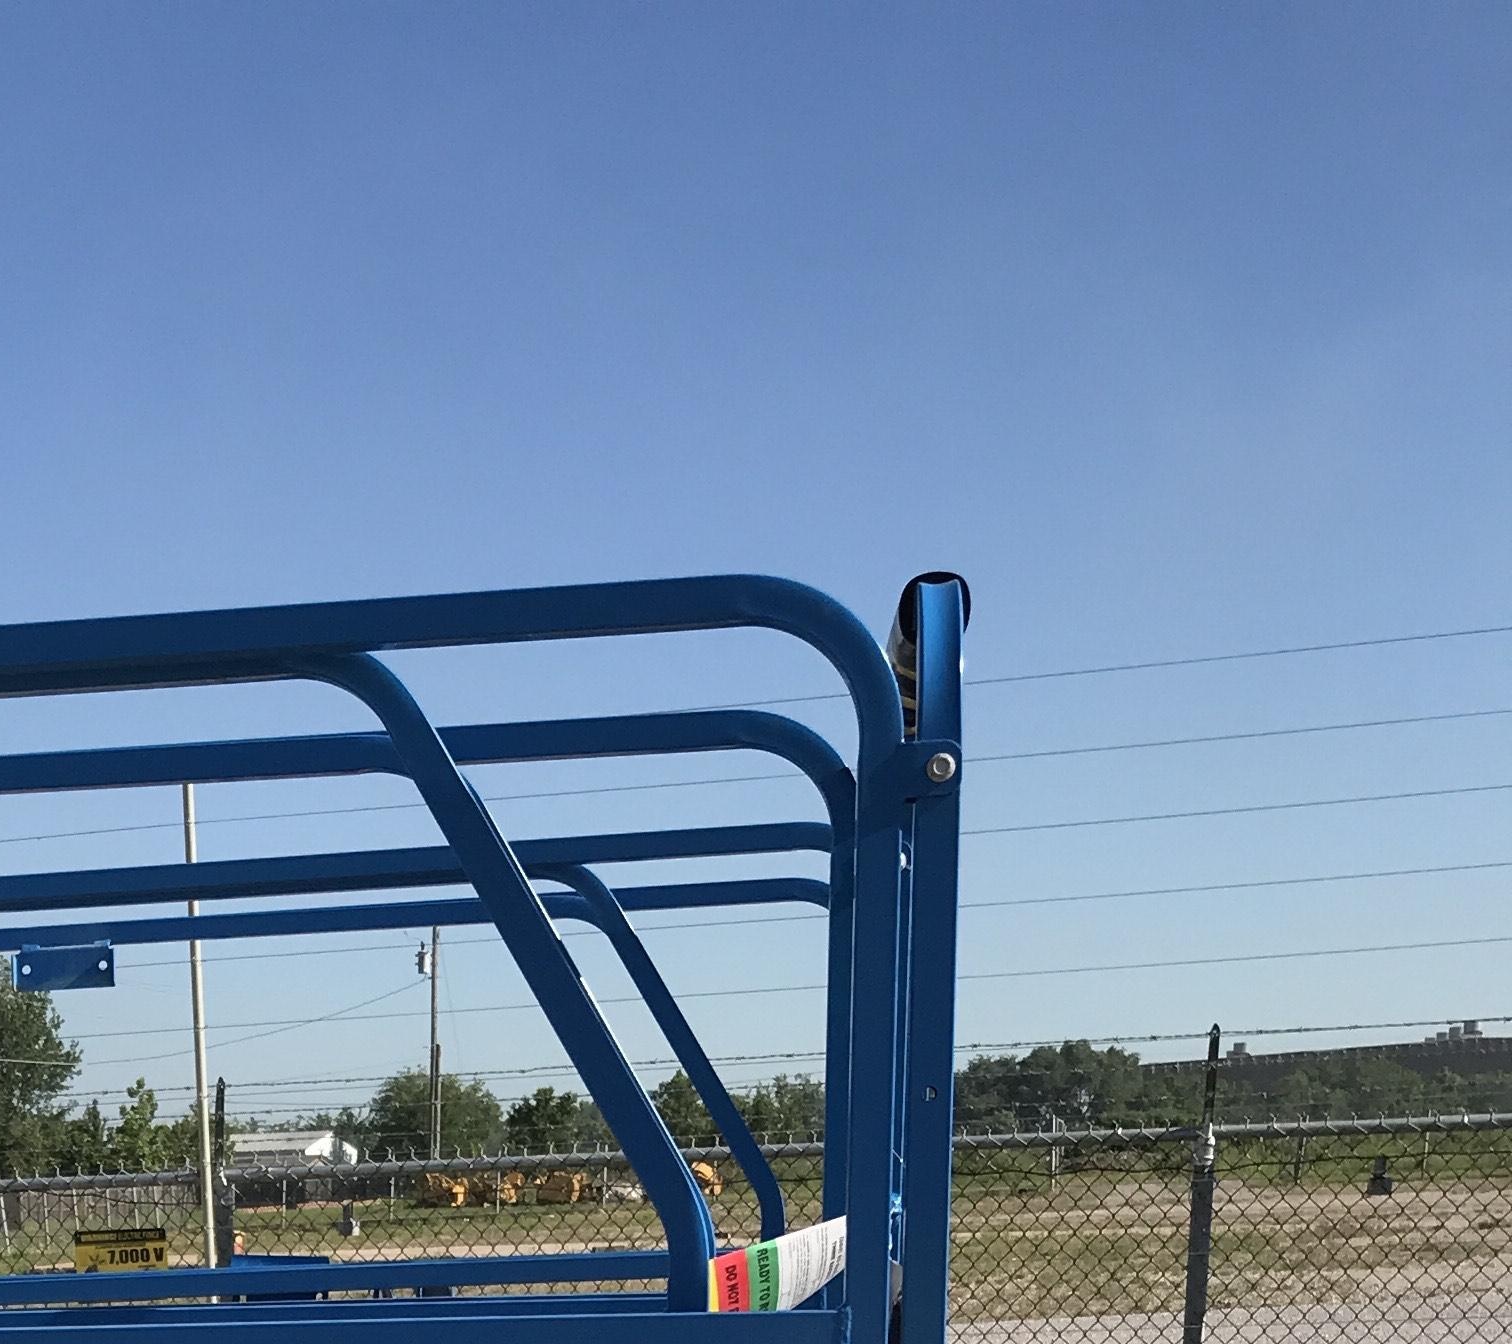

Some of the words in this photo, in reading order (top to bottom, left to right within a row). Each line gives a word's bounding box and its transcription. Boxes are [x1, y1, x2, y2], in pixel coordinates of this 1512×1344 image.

[107, 1249, 151, 1265] 7,000
[153, 1248, 164, 1262] V
[725, 1265, 737, 1282] DO
[757, 1248, 770, 1283] READY
[727, 1283, 739, 1305] NOT
[759, 1286, 770, 1301] TO
